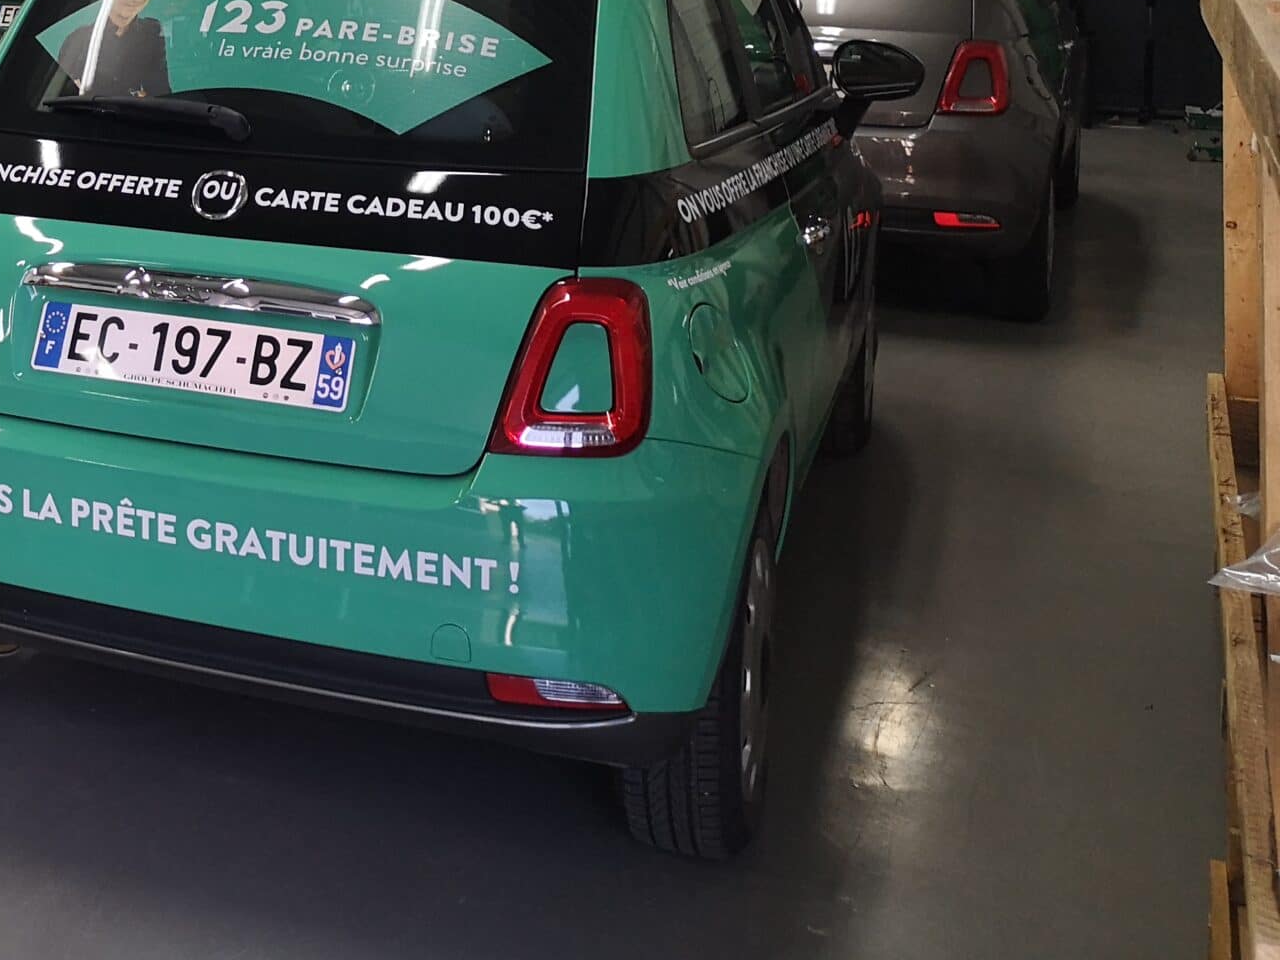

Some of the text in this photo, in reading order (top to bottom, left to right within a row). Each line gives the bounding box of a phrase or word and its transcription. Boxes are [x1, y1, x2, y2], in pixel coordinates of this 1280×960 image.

[218, 39, 468, 78] la vraie bonne surprise
[294, 17, 500, 58] PARE-BRISE
[76, 171, 183, 198] OFFERTE
[202, 180, 237, 201] OU
[254, 187, 341, 213] CARTE
[346, 194, 465, 223] CADEAU
[677, 194, 701, 224] ON
[694, 184, 727, 216] VOUS
[721, 170, 750, 205] OFFRE
[45, 340, 55, 354] F
[68, 312, 313, 392] EC-197-BZ
[316, 374, 344, 400] 59
[23, 488, 62, 524] LA
[71, 497, 177, 545] PRÊTE
[186, 518, 498, 591] GRATUITEMENT
[509, 561, 520, 594] !
